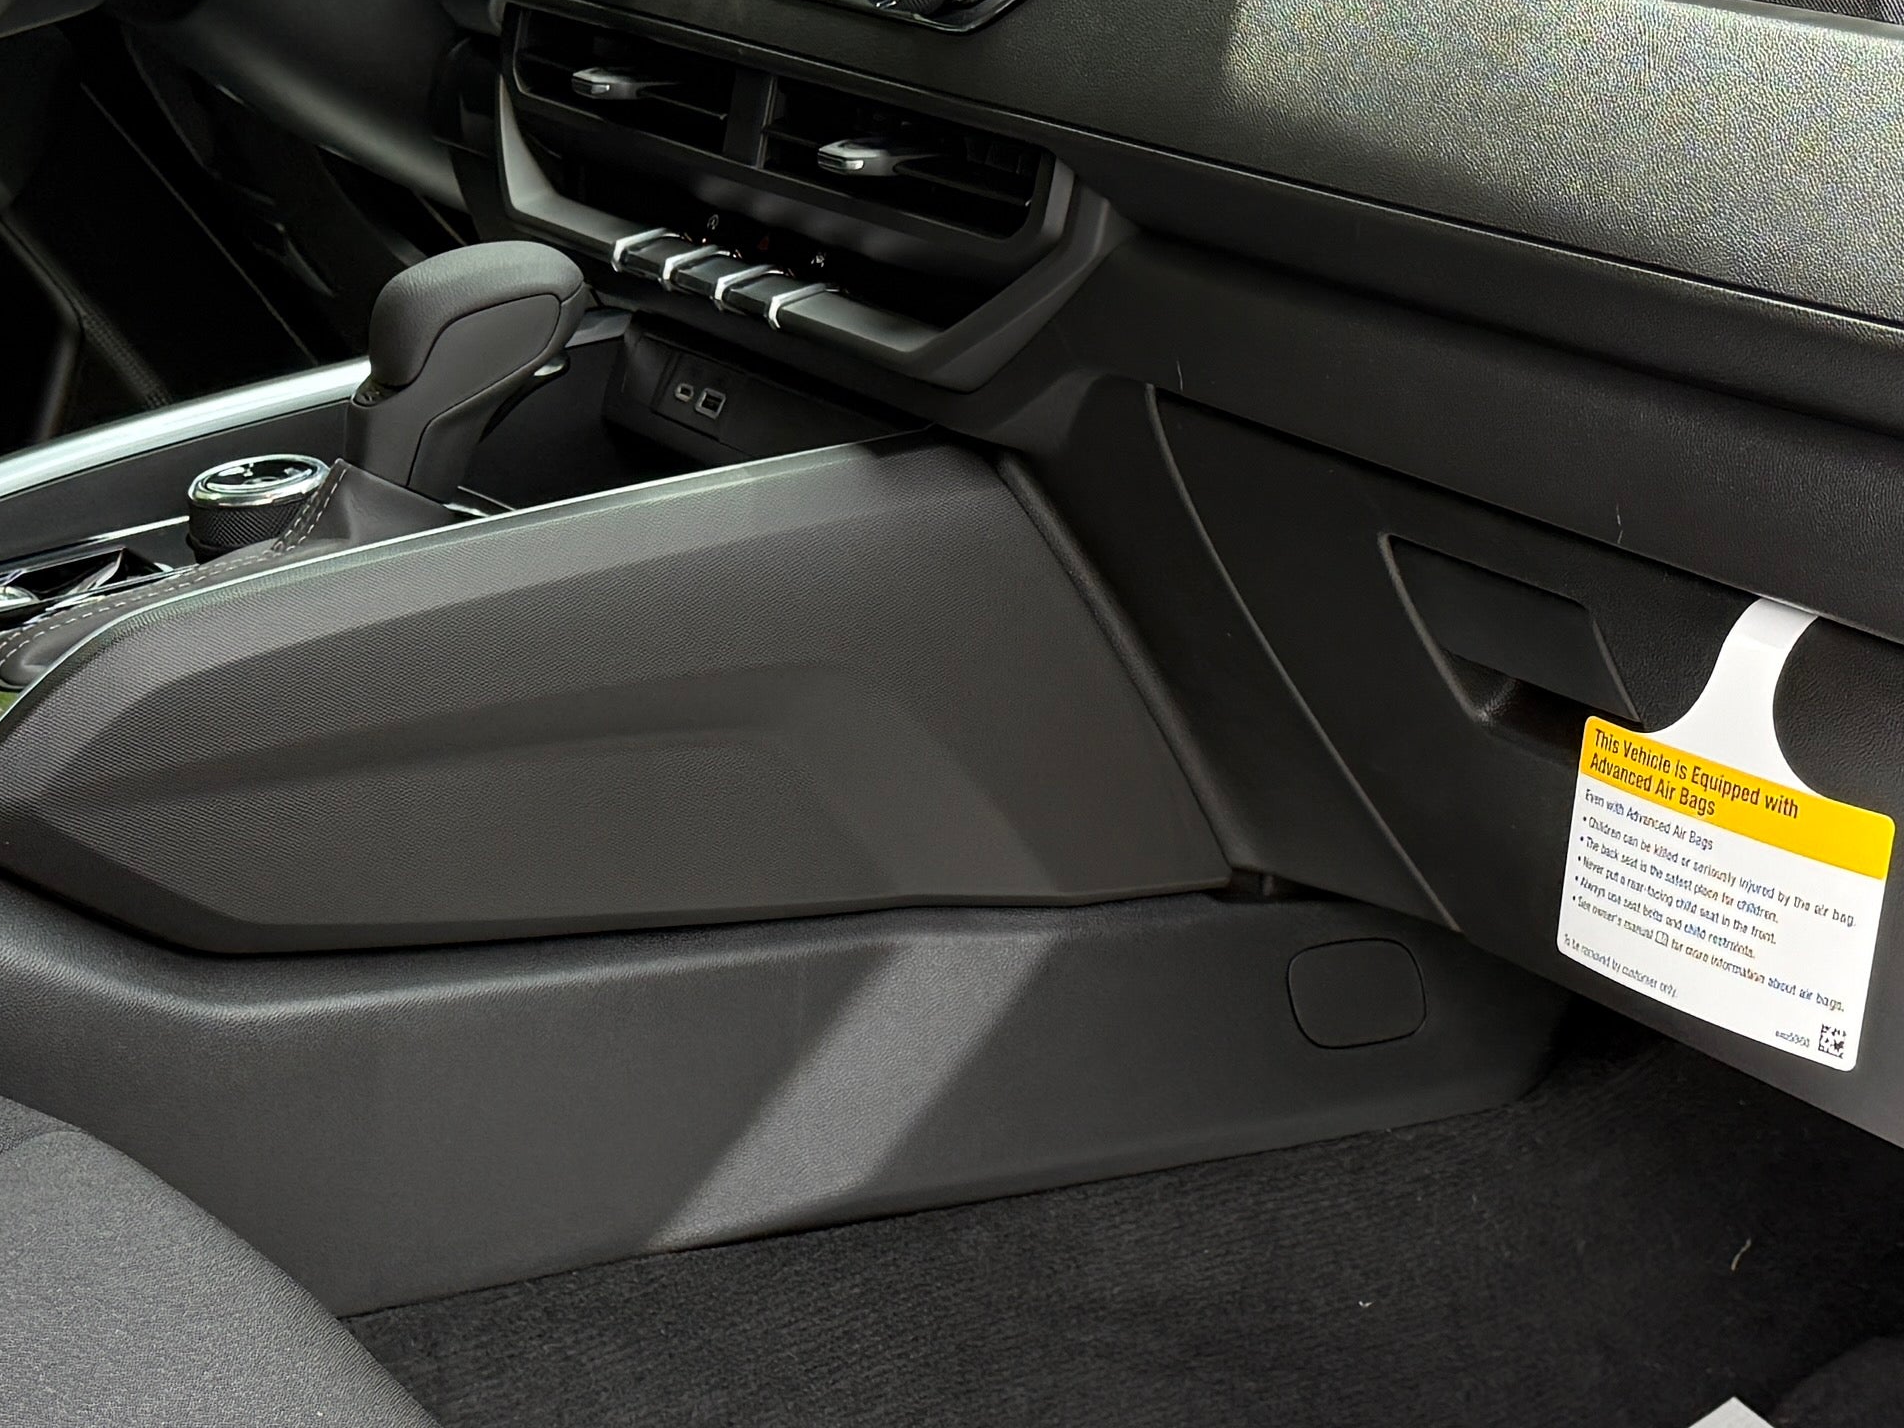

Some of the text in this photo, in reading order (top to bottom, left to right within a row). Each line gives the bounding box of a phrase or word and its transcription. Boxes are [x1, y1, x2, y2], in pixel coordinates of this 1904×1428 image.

[1590, 753, 1716, 816] Advanced Air Bags
[1595, 728, 1619, 754] This
[1623, 740, 1671, 774] Vehicle
[1691, 766, 1761, 805] Equipped
[1765, 795, 1799, 819] with
[1585, 788, 1714, 851] Even with Advanced Air Bags
[1582, 855, 1603, 875] Never
[1606, 868, 1619, 882] put
[1627, 877, 1673, 908] rear-facing
[1675, 897, 1698, 915] child
[1699, 906, 1720, 923] seat
[1722, 915, 1731, 927] in
[1733, 918, 1748, 934] the
[1751, 925, 1777, 945] front.
[1586, 836, 1599, 852] The
[1600, 844, 1619, 861] back
[1621, 853, 1638, 870] seat
[1649, 865, 1663, 879] the
[1664, 873, 1693, 892] safest
[1693, 883, 1718, 902] place
[1721, 892, 1734, 907] for
[1736, 899, 1779, 924] children.
[1588, 816, 1622, 840] Children
[1623, 833, 1638, 848] can
[1640, 838, 1651, 853] be
[1653, 843, 1678, 863] killed
[1681, 855, 1690, 867] or
[1693, 861, 1736, 887] seriously
[1739, 877, 1775, 900] injured
[1778, 890, 1791, 907] by
[1794, 895, 1810, 912] the
[1814, 904, 1829, 917] air
[1577, 895, 1591, 911] See
[1623, 919, 1654, 940] manual
[1671, 938, 1684, 953] for
[1685, 947, 1708, 963] more
[1710, 954, 1766, 985] information
[1767, 977, 1797, 996] about
[1799, 987, 1814, 1001] air
[1607, 891, 1622, 905] use
[1623, 897, 1641, 914] seat
[1665, 915, 1682, 931] and
[1684, 922, 1706, 940] child
